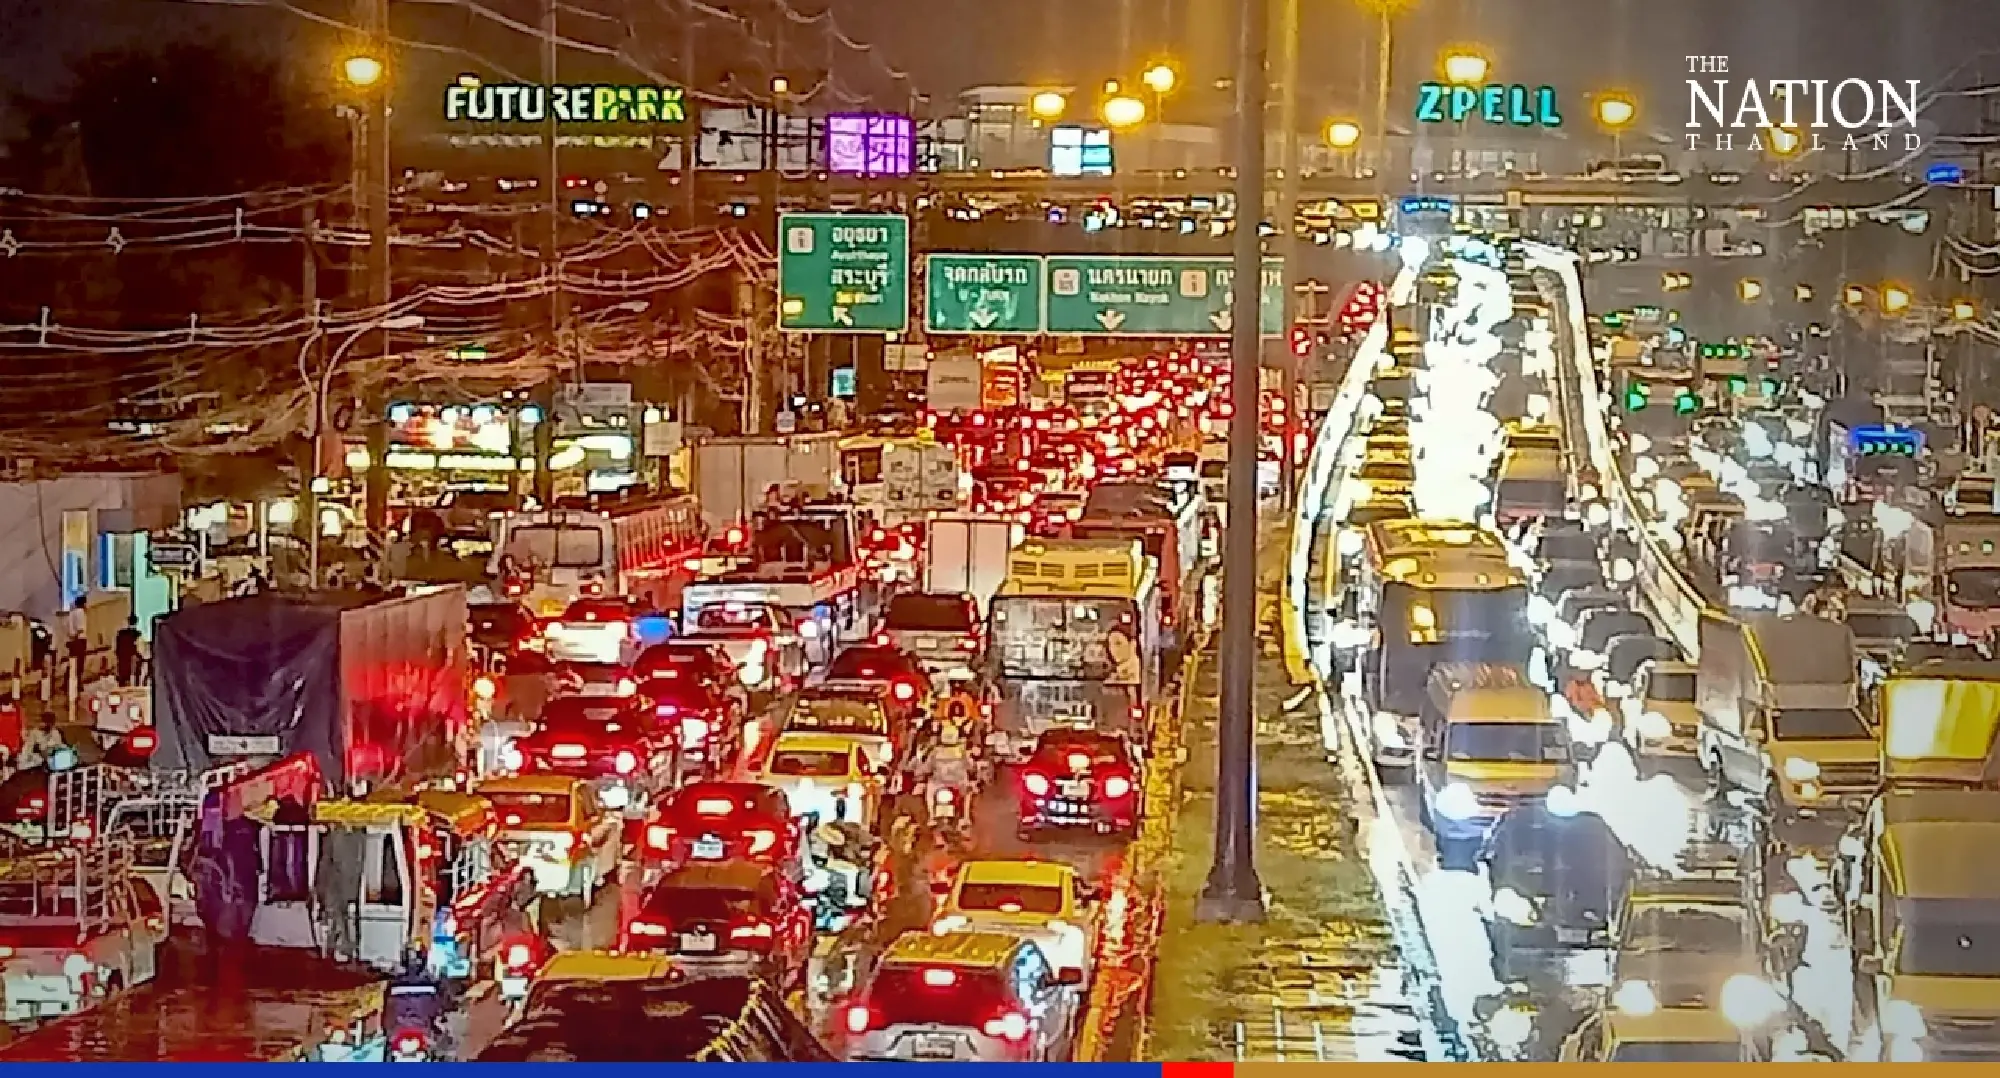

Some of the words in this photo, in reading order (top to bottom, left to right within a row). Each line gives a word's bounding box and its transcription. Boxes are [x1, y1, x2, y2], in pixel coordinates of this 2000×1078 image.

[1418, 85, 1560, 123] ZPELL
[831, 262, 888, 292] สระบุรี
[944, 261, 1028, 289] จุดกลับรถ
[1087, 268, 1173, 286] นครนายก
